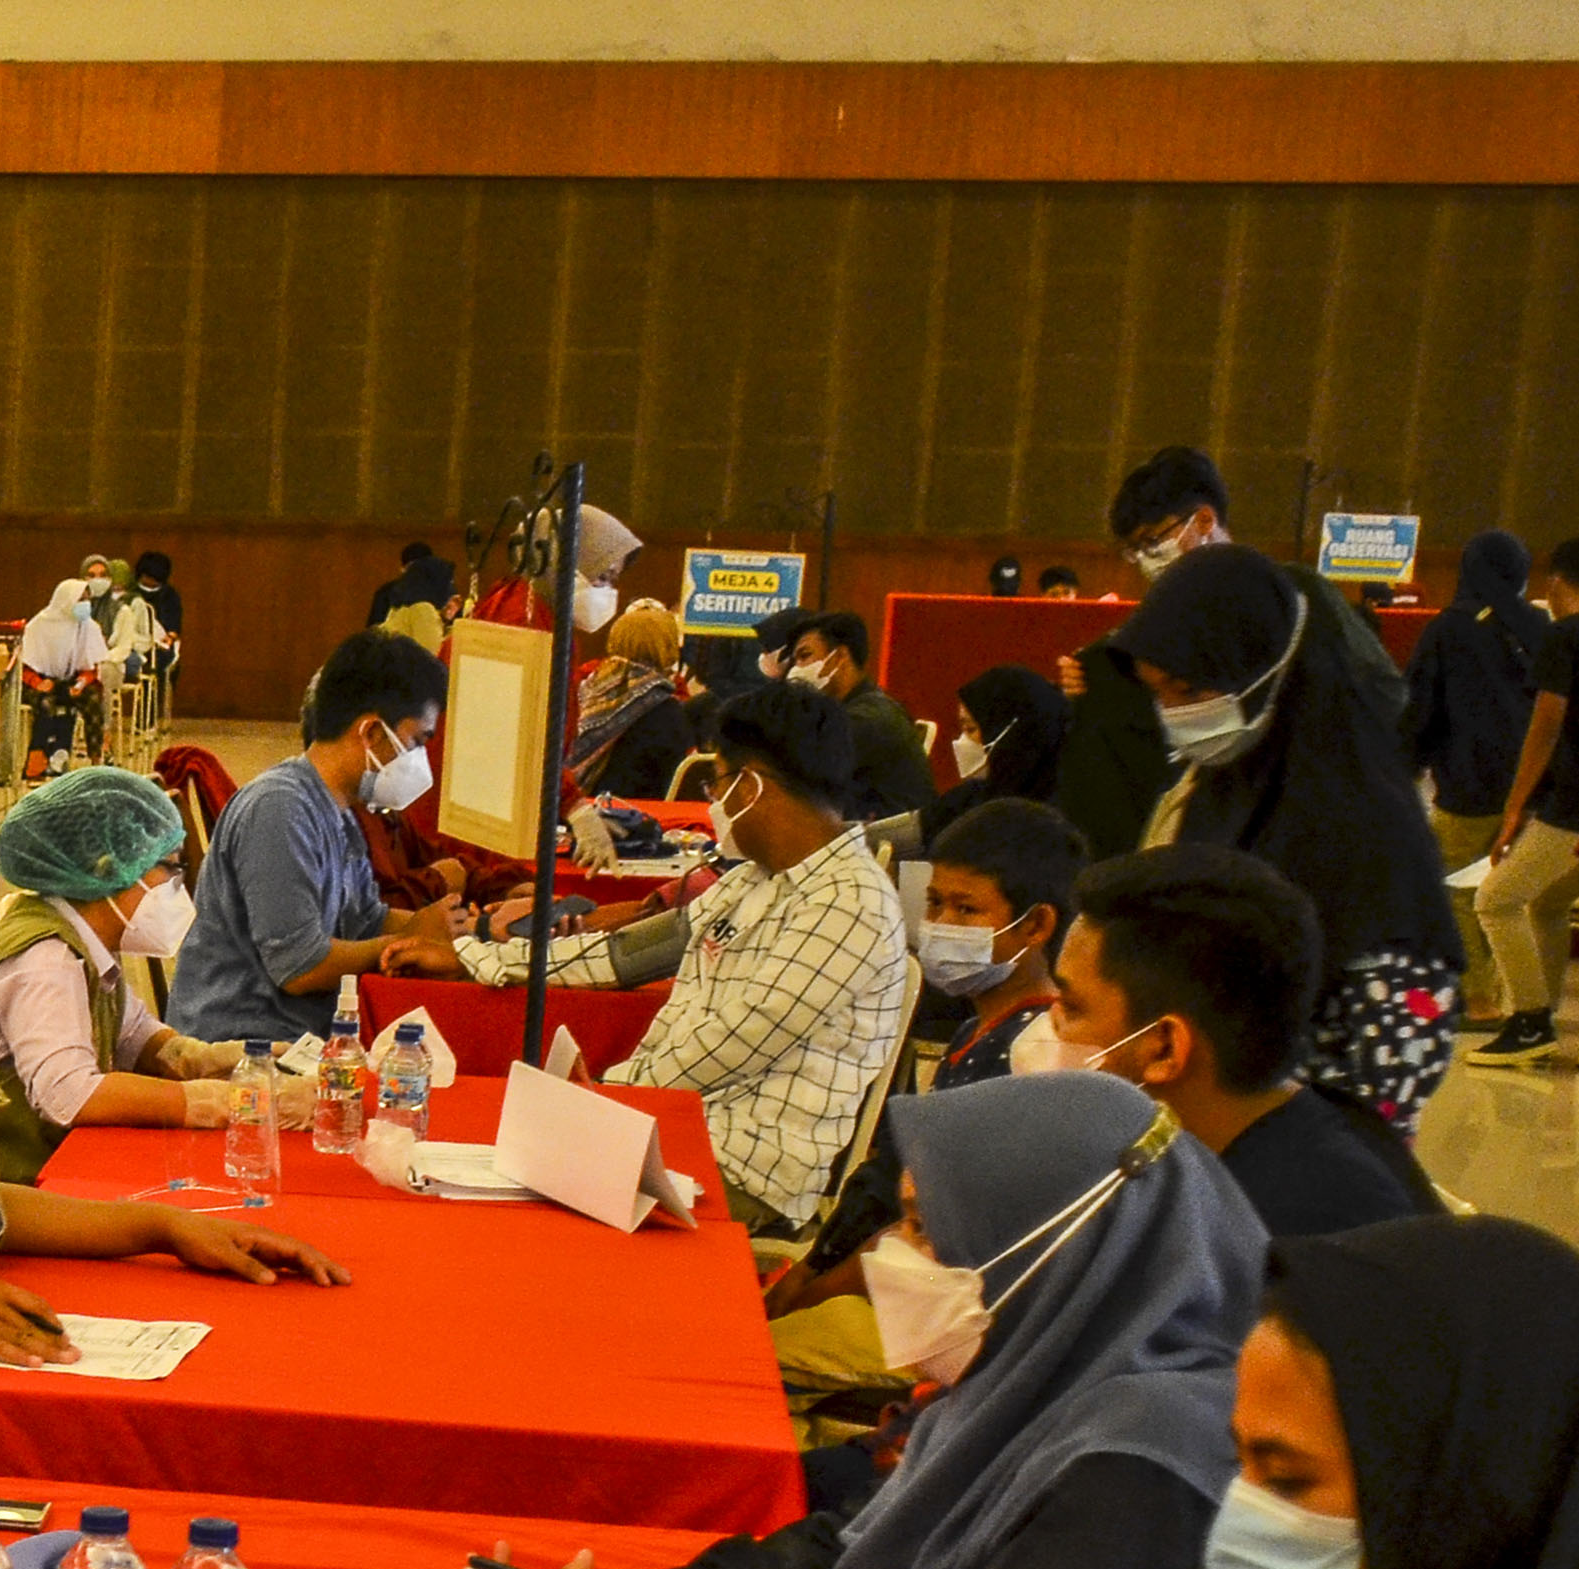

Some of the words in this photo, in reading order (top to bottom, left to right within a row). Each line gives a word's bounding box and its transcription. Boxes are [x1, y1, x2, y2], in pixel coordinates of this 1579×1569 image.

[1329, 542, 1410, 559] OBSERVASI
[713, 574, 759, 588] MEJA
[764, 576, 774, 589] 4
[693, 593, 791, 614] SERTIFIKAT
